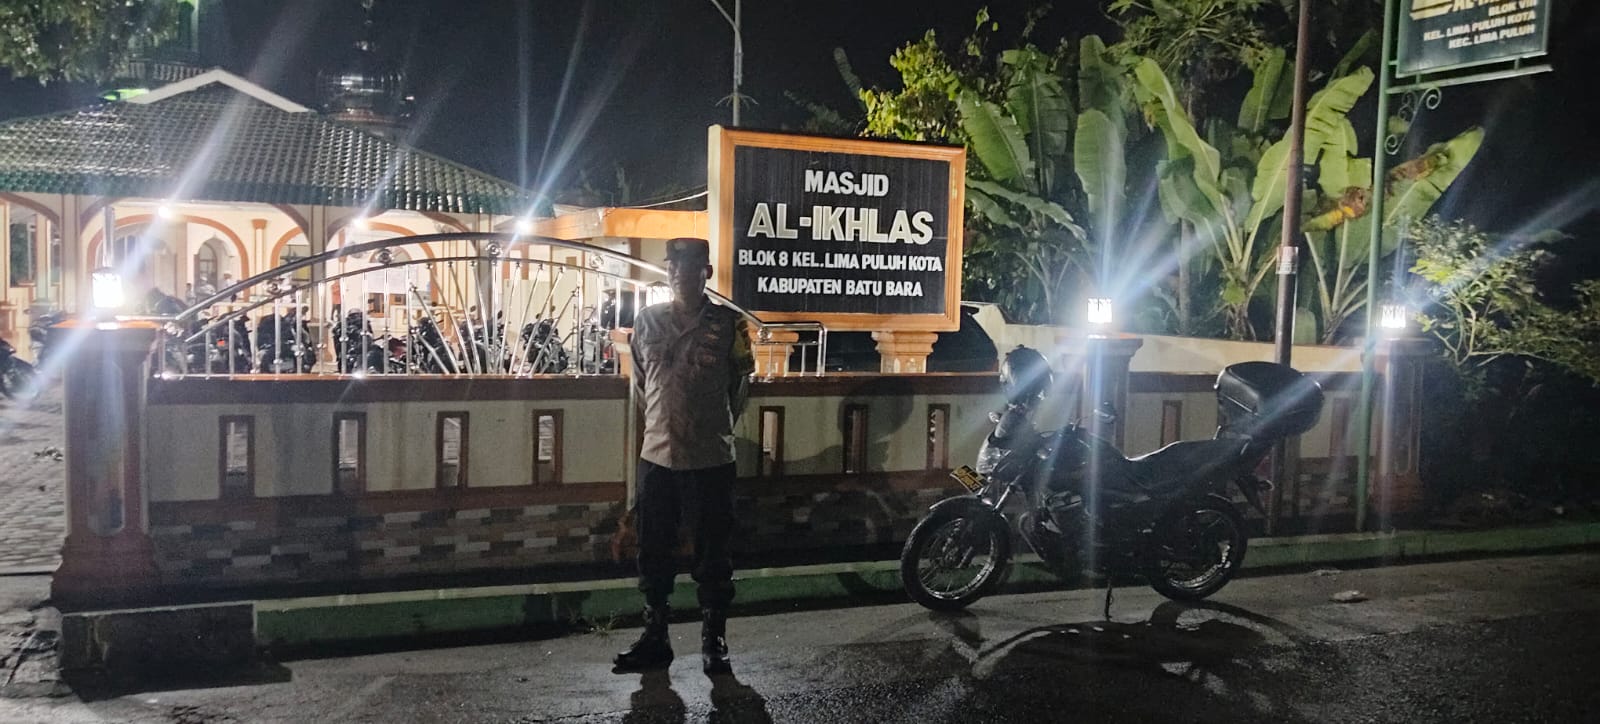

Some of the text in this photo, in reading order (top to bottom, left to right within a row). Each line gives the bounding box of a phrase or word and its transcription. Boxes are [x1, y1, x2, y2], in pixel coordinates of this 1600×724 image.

[1488, 2, 1517, 16] BLOK
[1424, 10, 1536, 41] KEL. LIMA PULUH KOTA
[1474, 31, 1498, 45] LIMA
[1499, 24, 1535, 39] PULUH
[804, 169, 889, 197] MASJID
[747, 202, 934, 245] AL-IKHLAS
[738, 249, 776, 266] BLOK
[778, 252, 789, 267] 8
[861, 254, 907, 271] PULUH
[908, 255, 943, 272] KOTA
[757, 276, 923, 297] KABUPATEN BATU BARA
